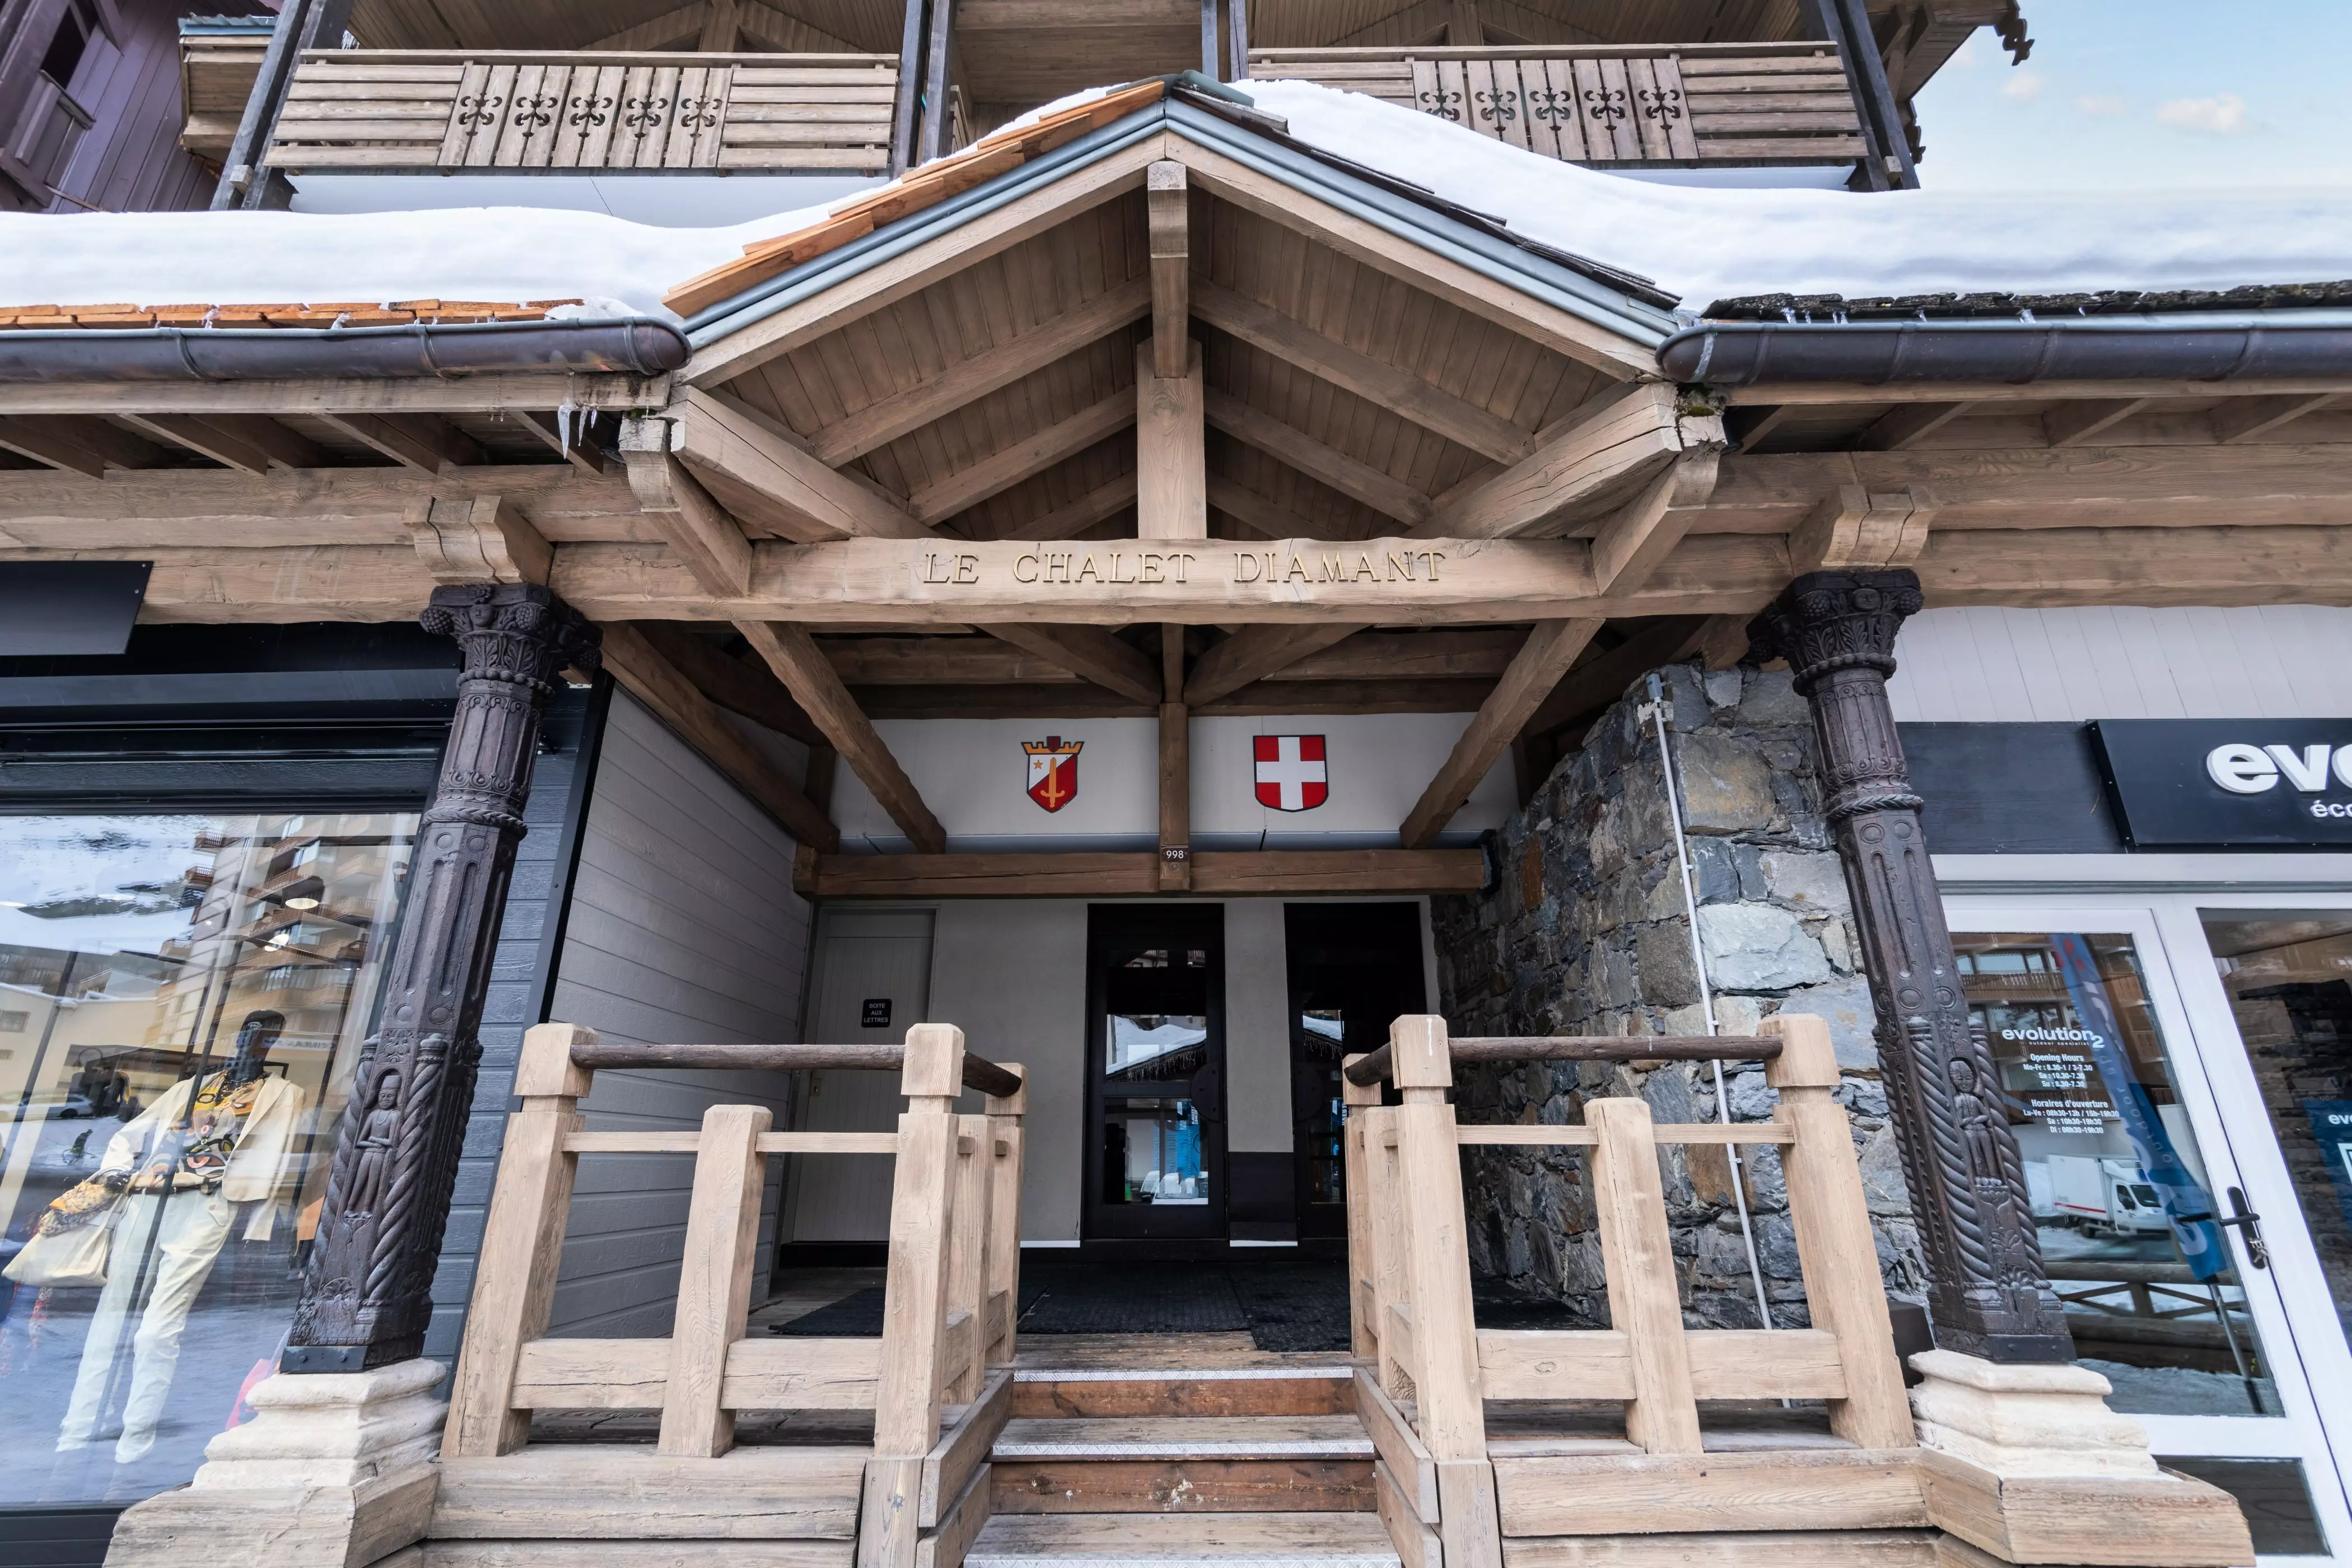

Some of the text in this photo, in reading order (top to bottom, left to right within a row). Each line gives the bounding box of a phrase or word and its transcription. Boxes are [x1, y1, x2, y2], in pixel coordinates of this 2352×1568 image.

[923, 551, 1446, 584] LE CHALET DIAMANT
[1166, 850, 1184, 858] 998
[2030, 1053, 2061, 1063] Opening
